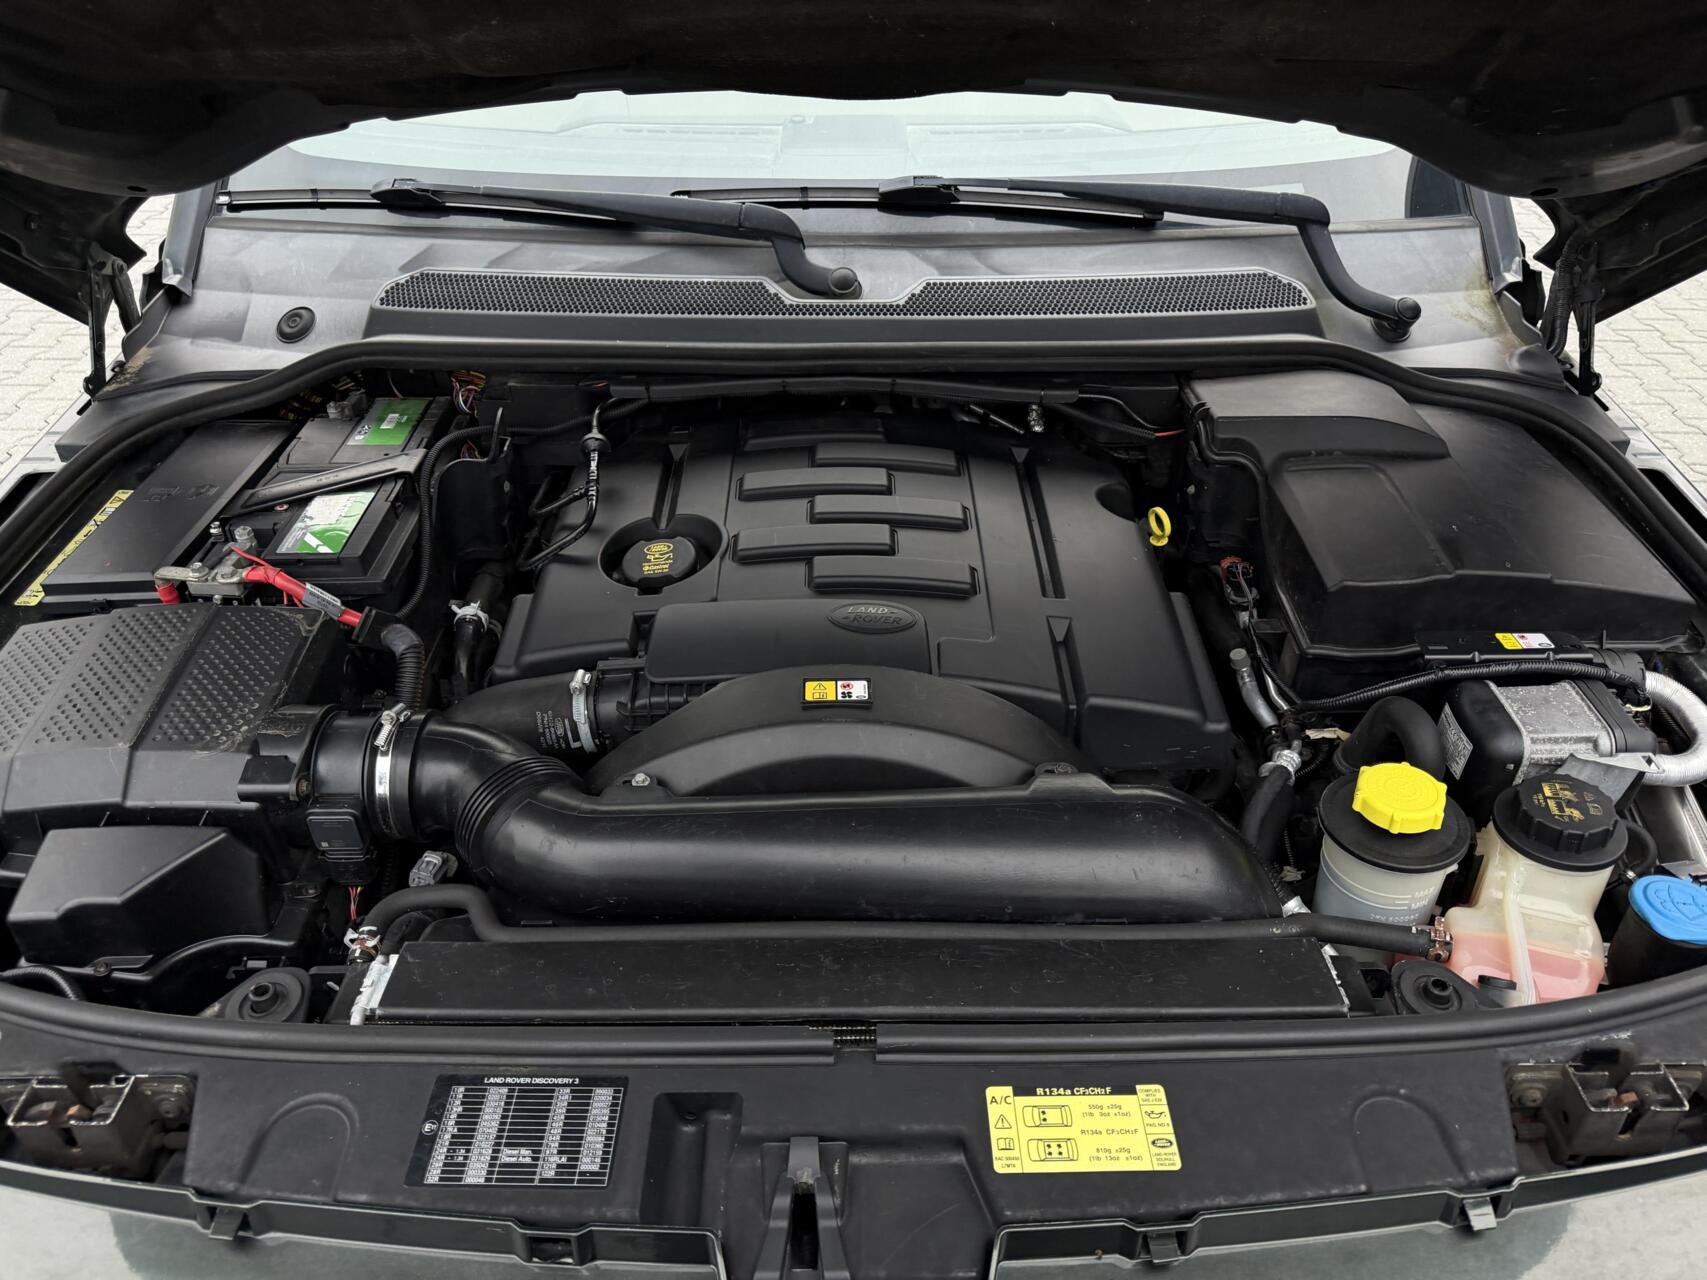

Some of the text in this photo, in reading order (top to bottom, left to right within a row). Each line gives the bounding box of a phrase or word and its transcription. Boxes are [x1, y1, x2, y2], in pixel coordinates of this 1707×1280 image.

[852, 614, 901, 624] ROVER
[1036, 1088, 1071, 1096] R134a
[990, 1096, 1012, 1105] A/C
